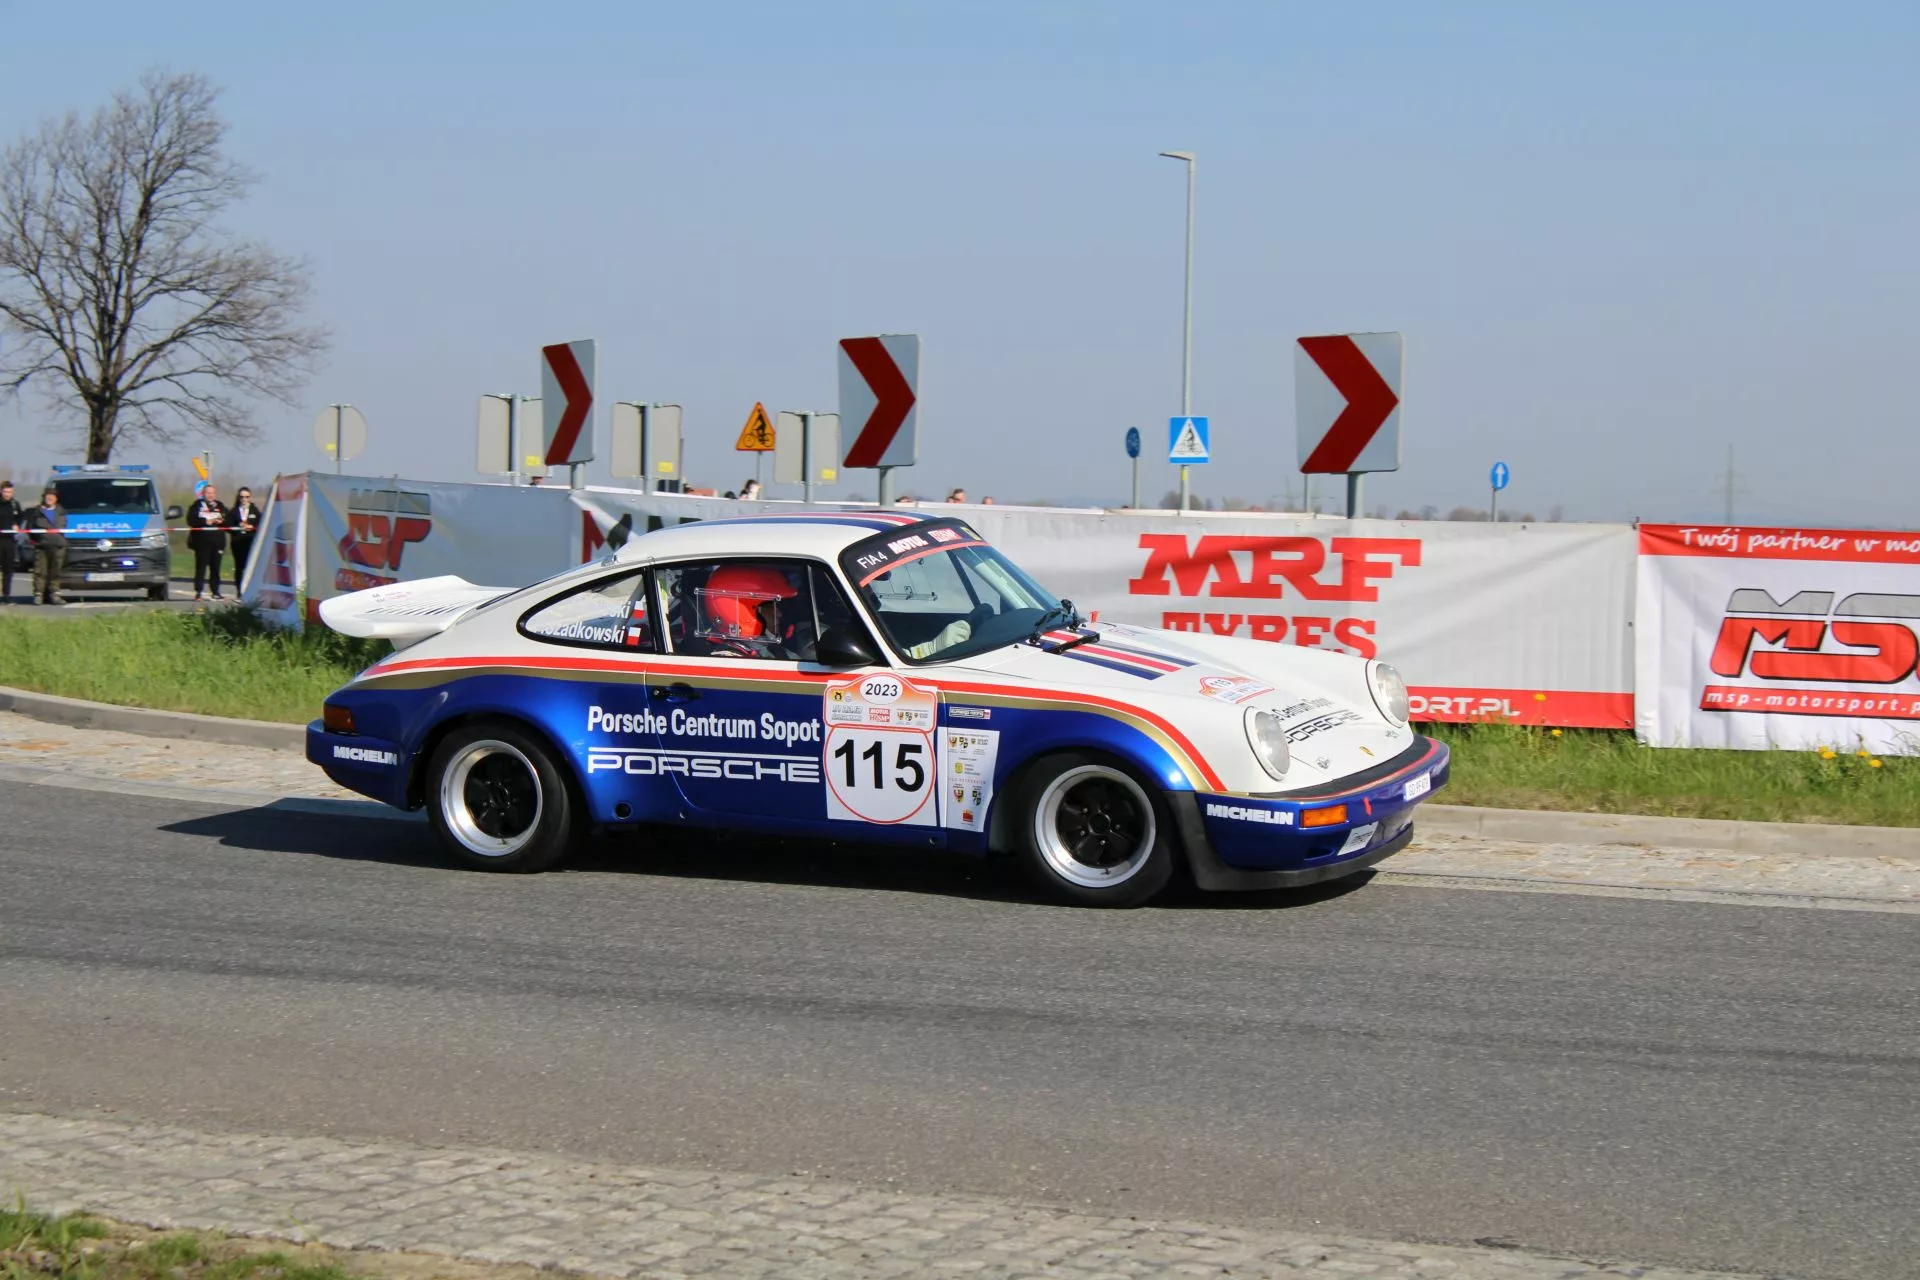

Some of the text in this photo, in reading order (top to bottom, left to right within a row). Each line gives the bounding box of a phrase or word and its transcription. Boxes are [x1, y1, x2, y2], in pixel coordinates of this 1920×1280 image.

[888, 535, 929, 555] MOTUL
[1679, 528, 1739, 551] Twój
[1748, 531, 1846, 552] partner
[1854, 539, 1881, 552] w
[856, 551, 889, 569] FIA 4
[1129, 533, 1421, 602] MRF
[865, 683, 898, 697] 2023
[588, 706, 667, 735] Porsche
[671, 708, 756, 739] Centrum
[761, 712, 820, 747] Sopot
[333, 745, 398, 766] MICHELIN
[835, 738, 925, 793] 115
[588, 754, 820, 783] PORSCHE
[1206, 803, 1294, 826] MICHELIN
